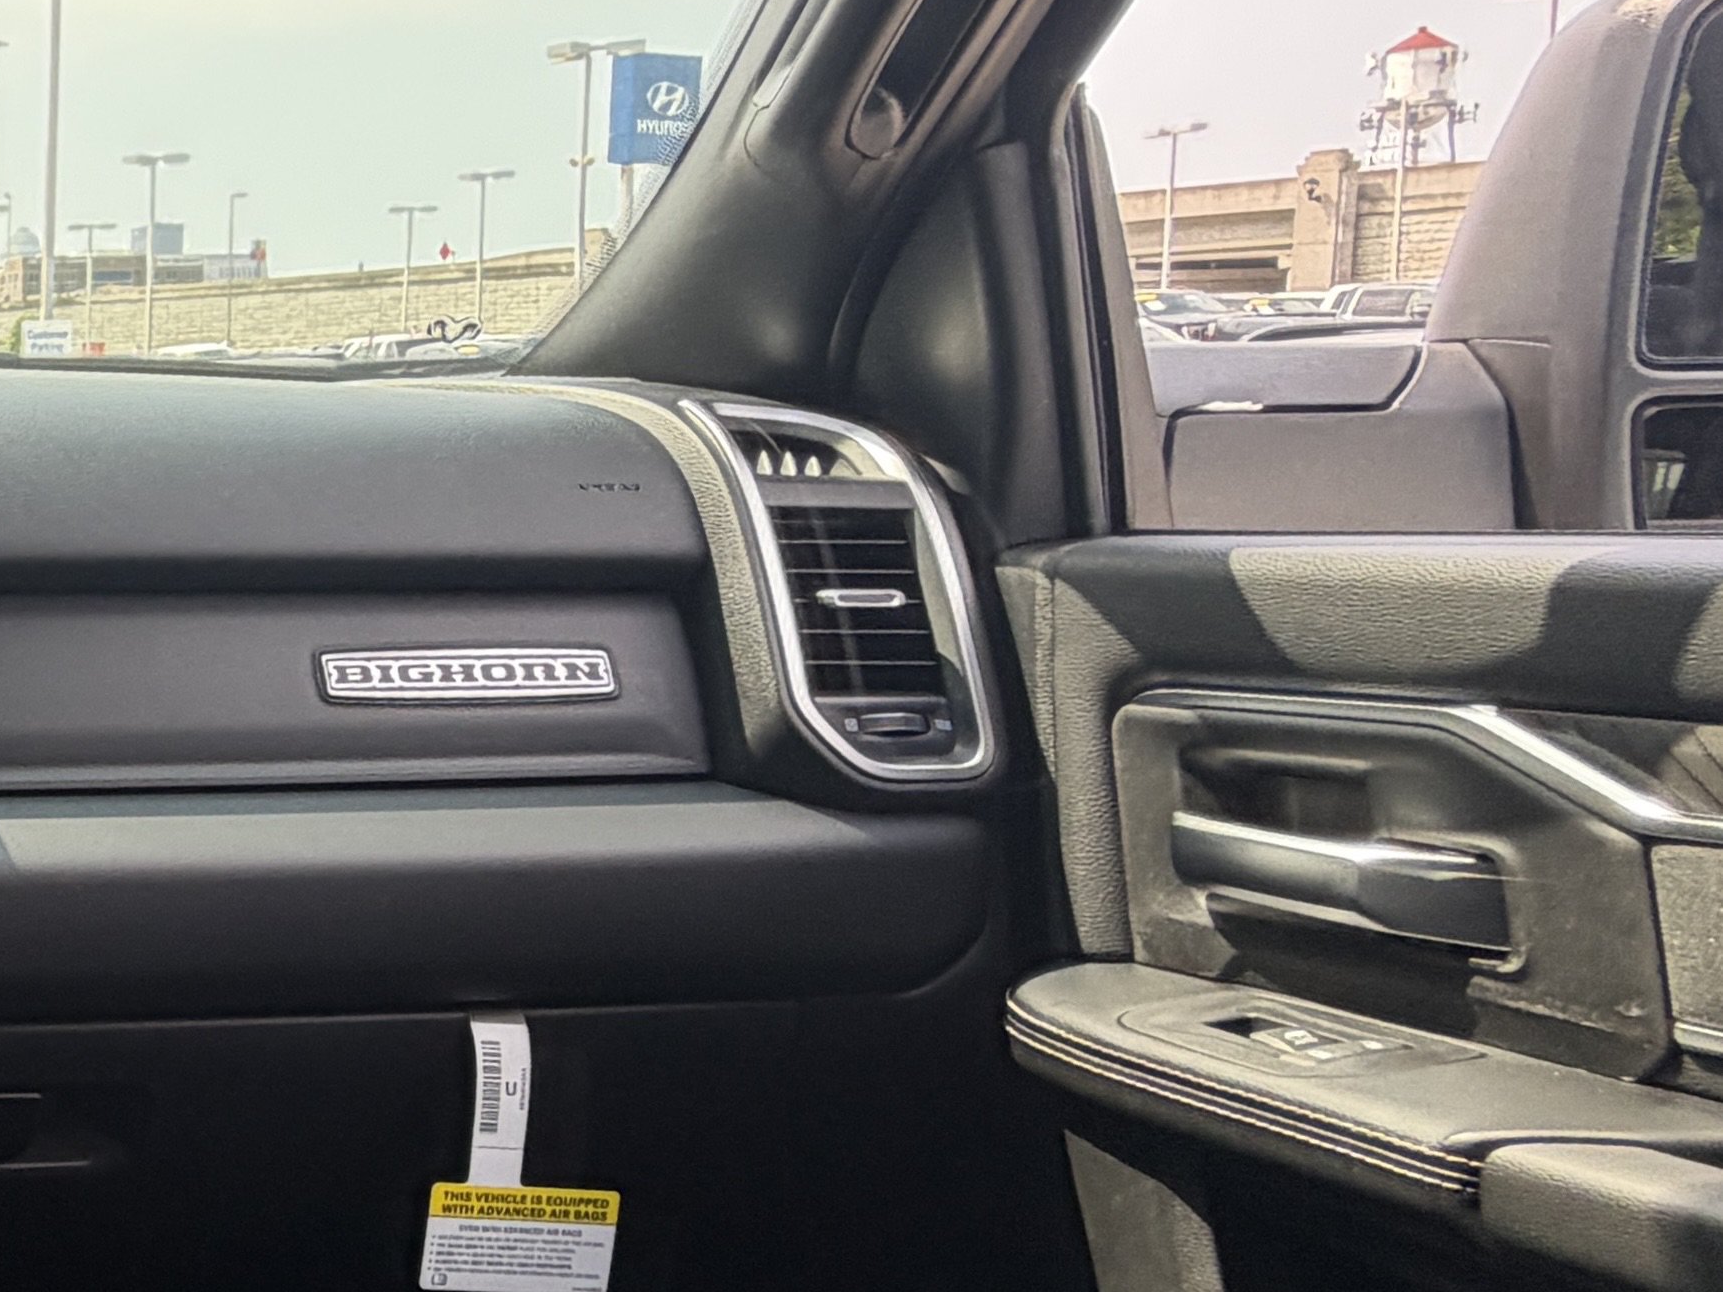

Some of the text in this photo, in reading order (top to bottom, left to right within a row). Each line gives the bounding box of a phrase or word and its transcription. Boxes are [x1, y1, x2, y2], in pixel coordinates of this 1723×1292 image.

[333, 661, 606, 685] BIGHORN
[443, 1190, 610, 1209] THIS VEHICLE IS EQUIPPED
[441, 1203, 609, 1222] WITH ADVANCED AIR BAGS
